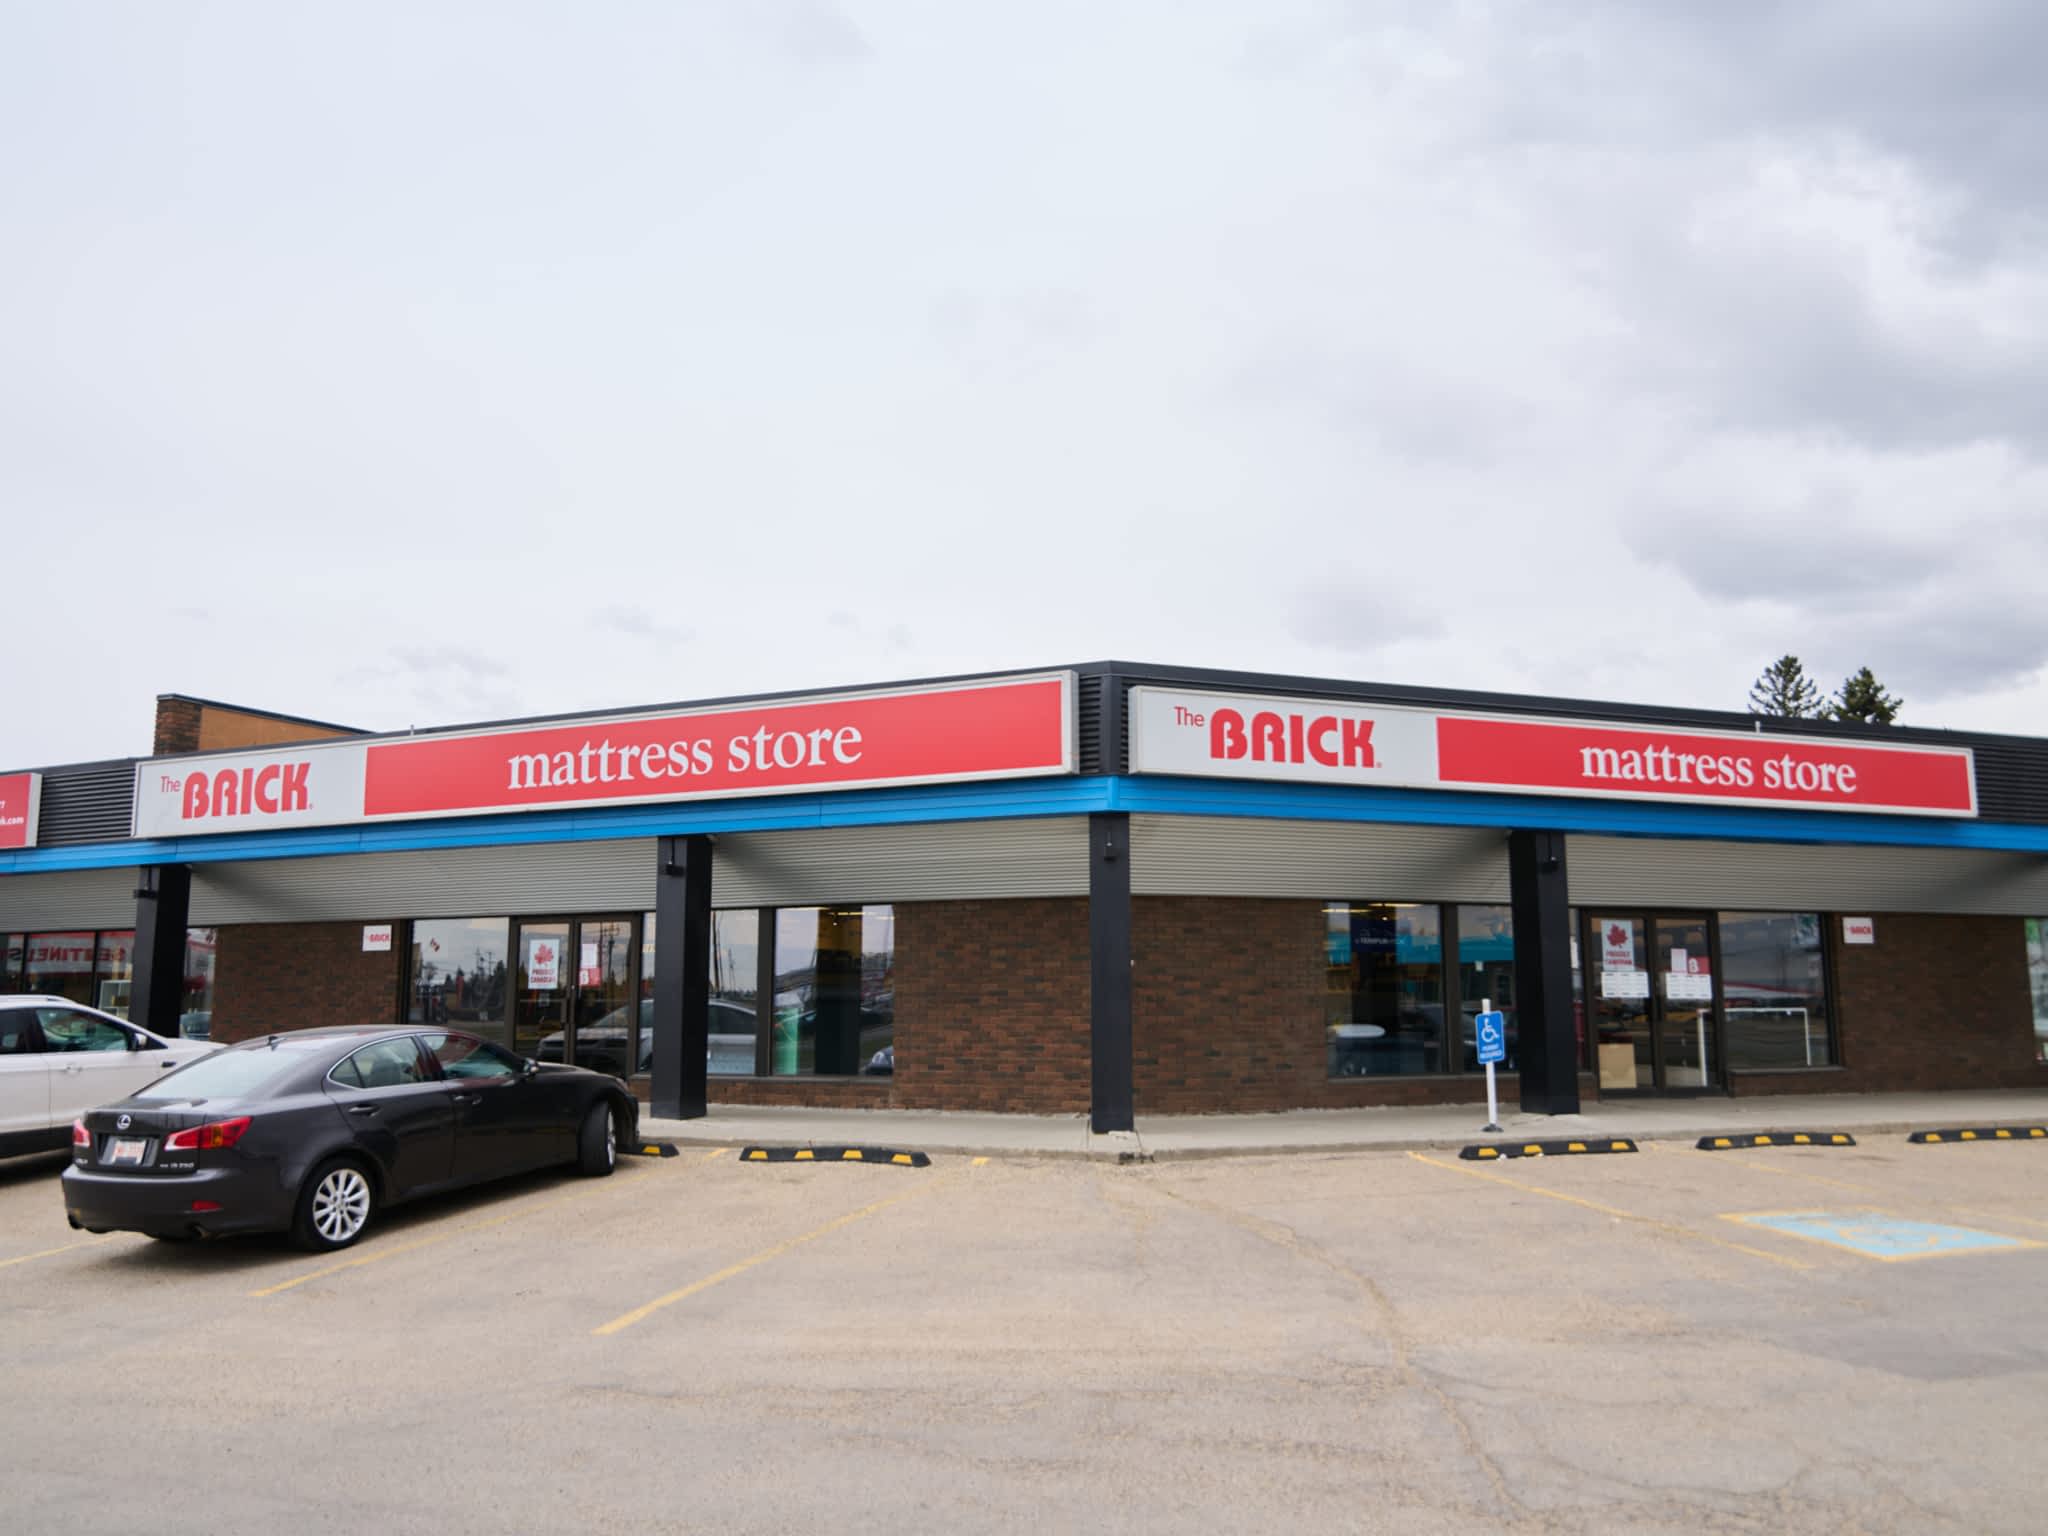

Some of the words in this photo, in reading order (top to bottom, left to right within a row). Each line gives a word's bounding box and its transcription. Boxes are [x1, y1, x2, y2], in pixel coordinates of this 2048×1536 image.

[507, 738, 714, 790] mattress
[727, 725, 863, 773] store
[1174, 706, 1205, 727] The
[1209, 707, 1376, 769] BRICK
[160, 775, 181, 793] The
[182, 762, 311, 820] BRICK
[1580, 743, 1754, 787] mattress
[1763, 754, 1857, 793] store
